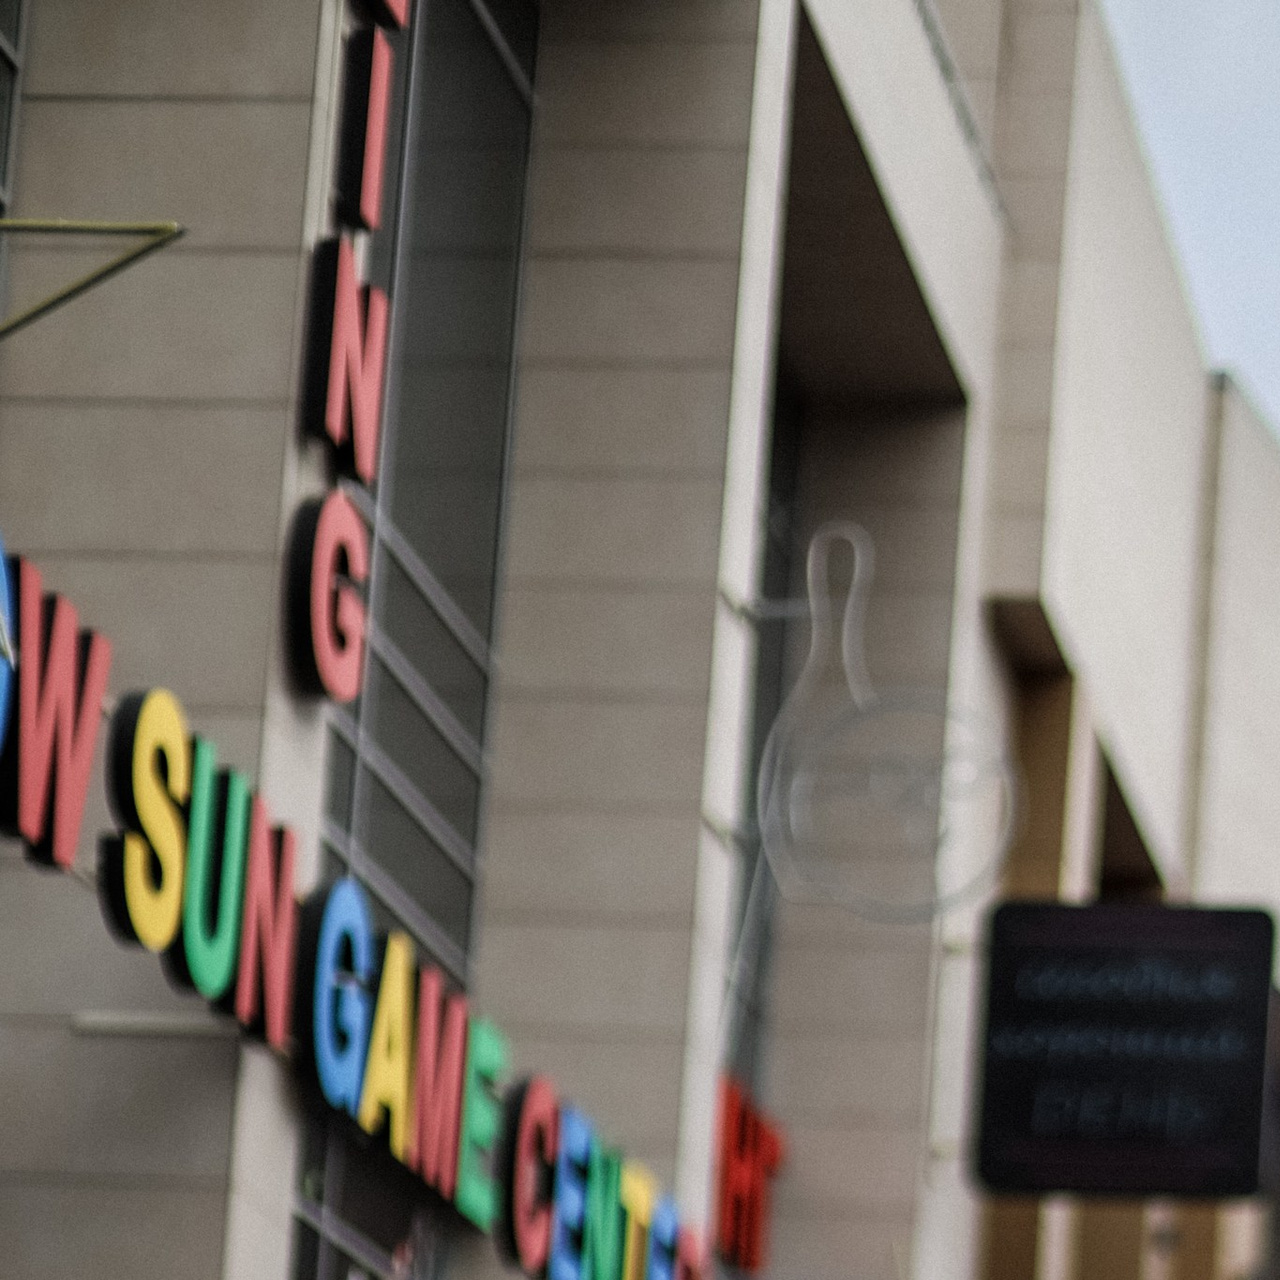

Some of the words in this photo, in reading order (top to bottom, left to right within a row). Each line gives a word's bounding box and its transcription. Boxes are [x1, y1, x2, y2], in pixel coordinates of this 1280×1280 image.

[310, 0, 409, 703] ING
[0, 532, 112, 870] W
[123, 686, 297, 1052] SUN
[312, 872, 512, 1236] GAME
